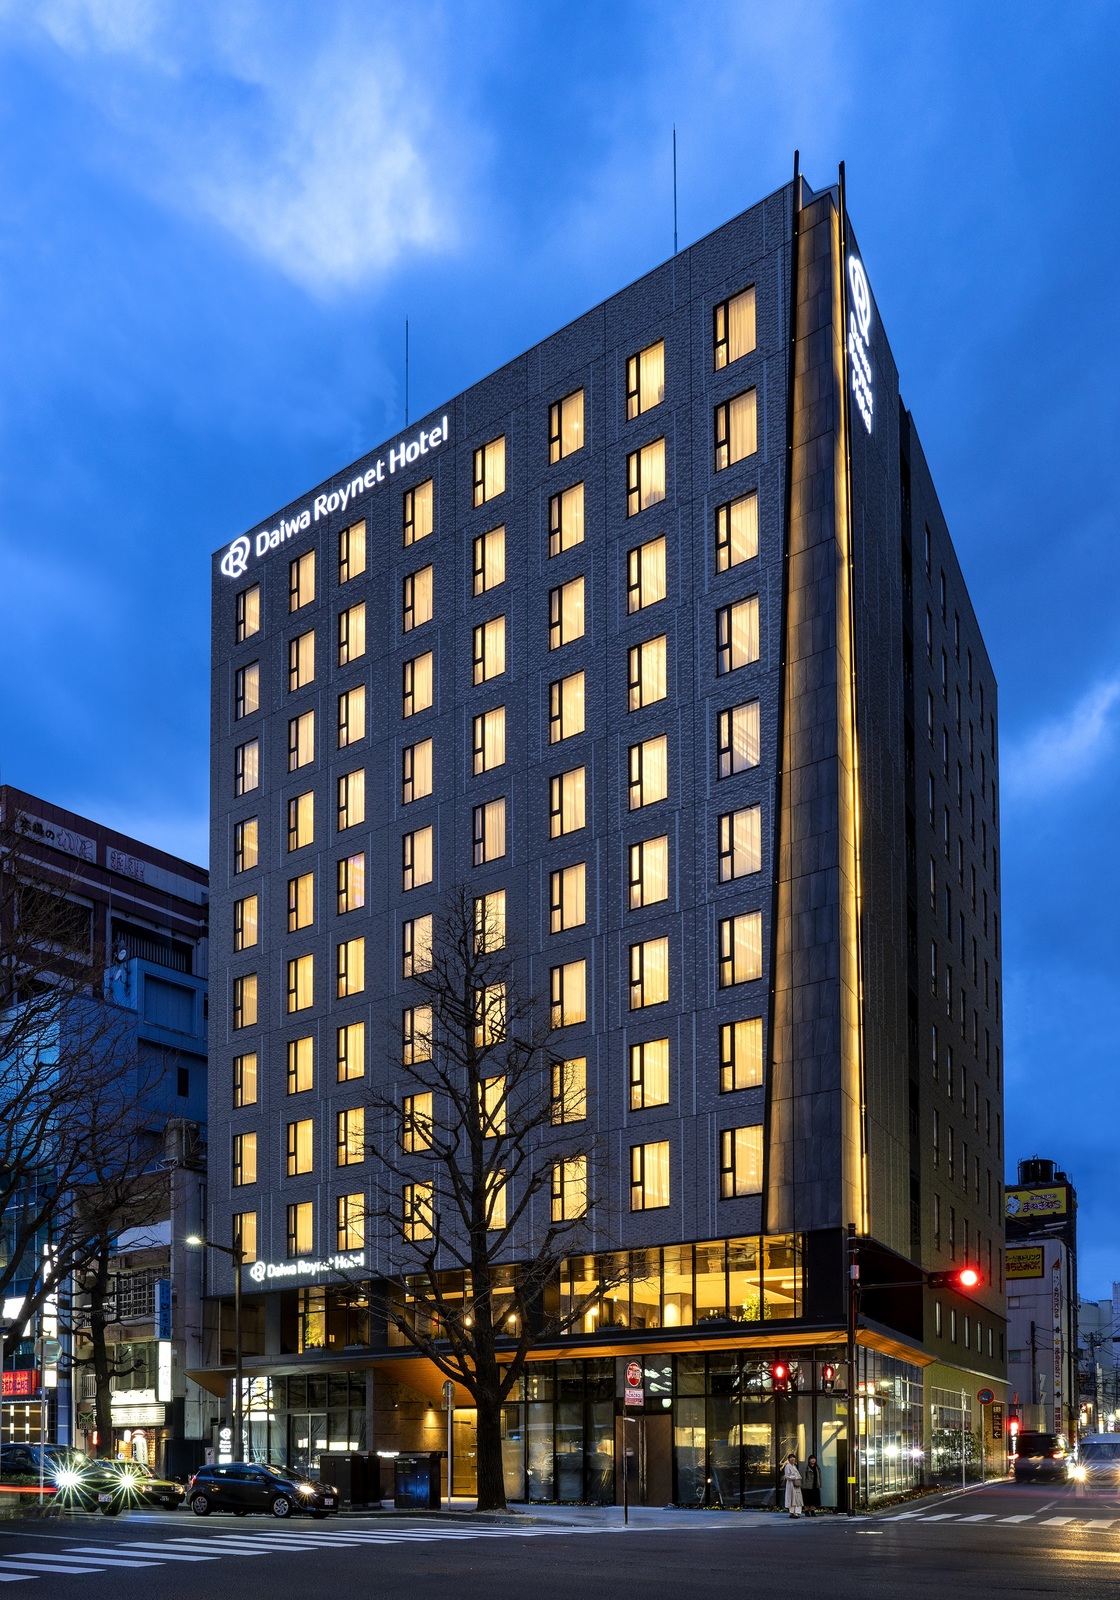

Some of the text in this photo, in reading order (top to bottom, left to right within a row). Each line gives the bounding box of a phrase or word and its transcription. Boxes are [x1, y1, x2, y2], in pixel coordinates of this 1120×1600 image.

[256, 510, 311, 557] Daiwa
[314, 459, 385, 521] Roynet
[390, 416, 448, 474] Hotel
[111, 851, 145, 882] 料理
[267, 1263, 297, 1278] Daiwa
